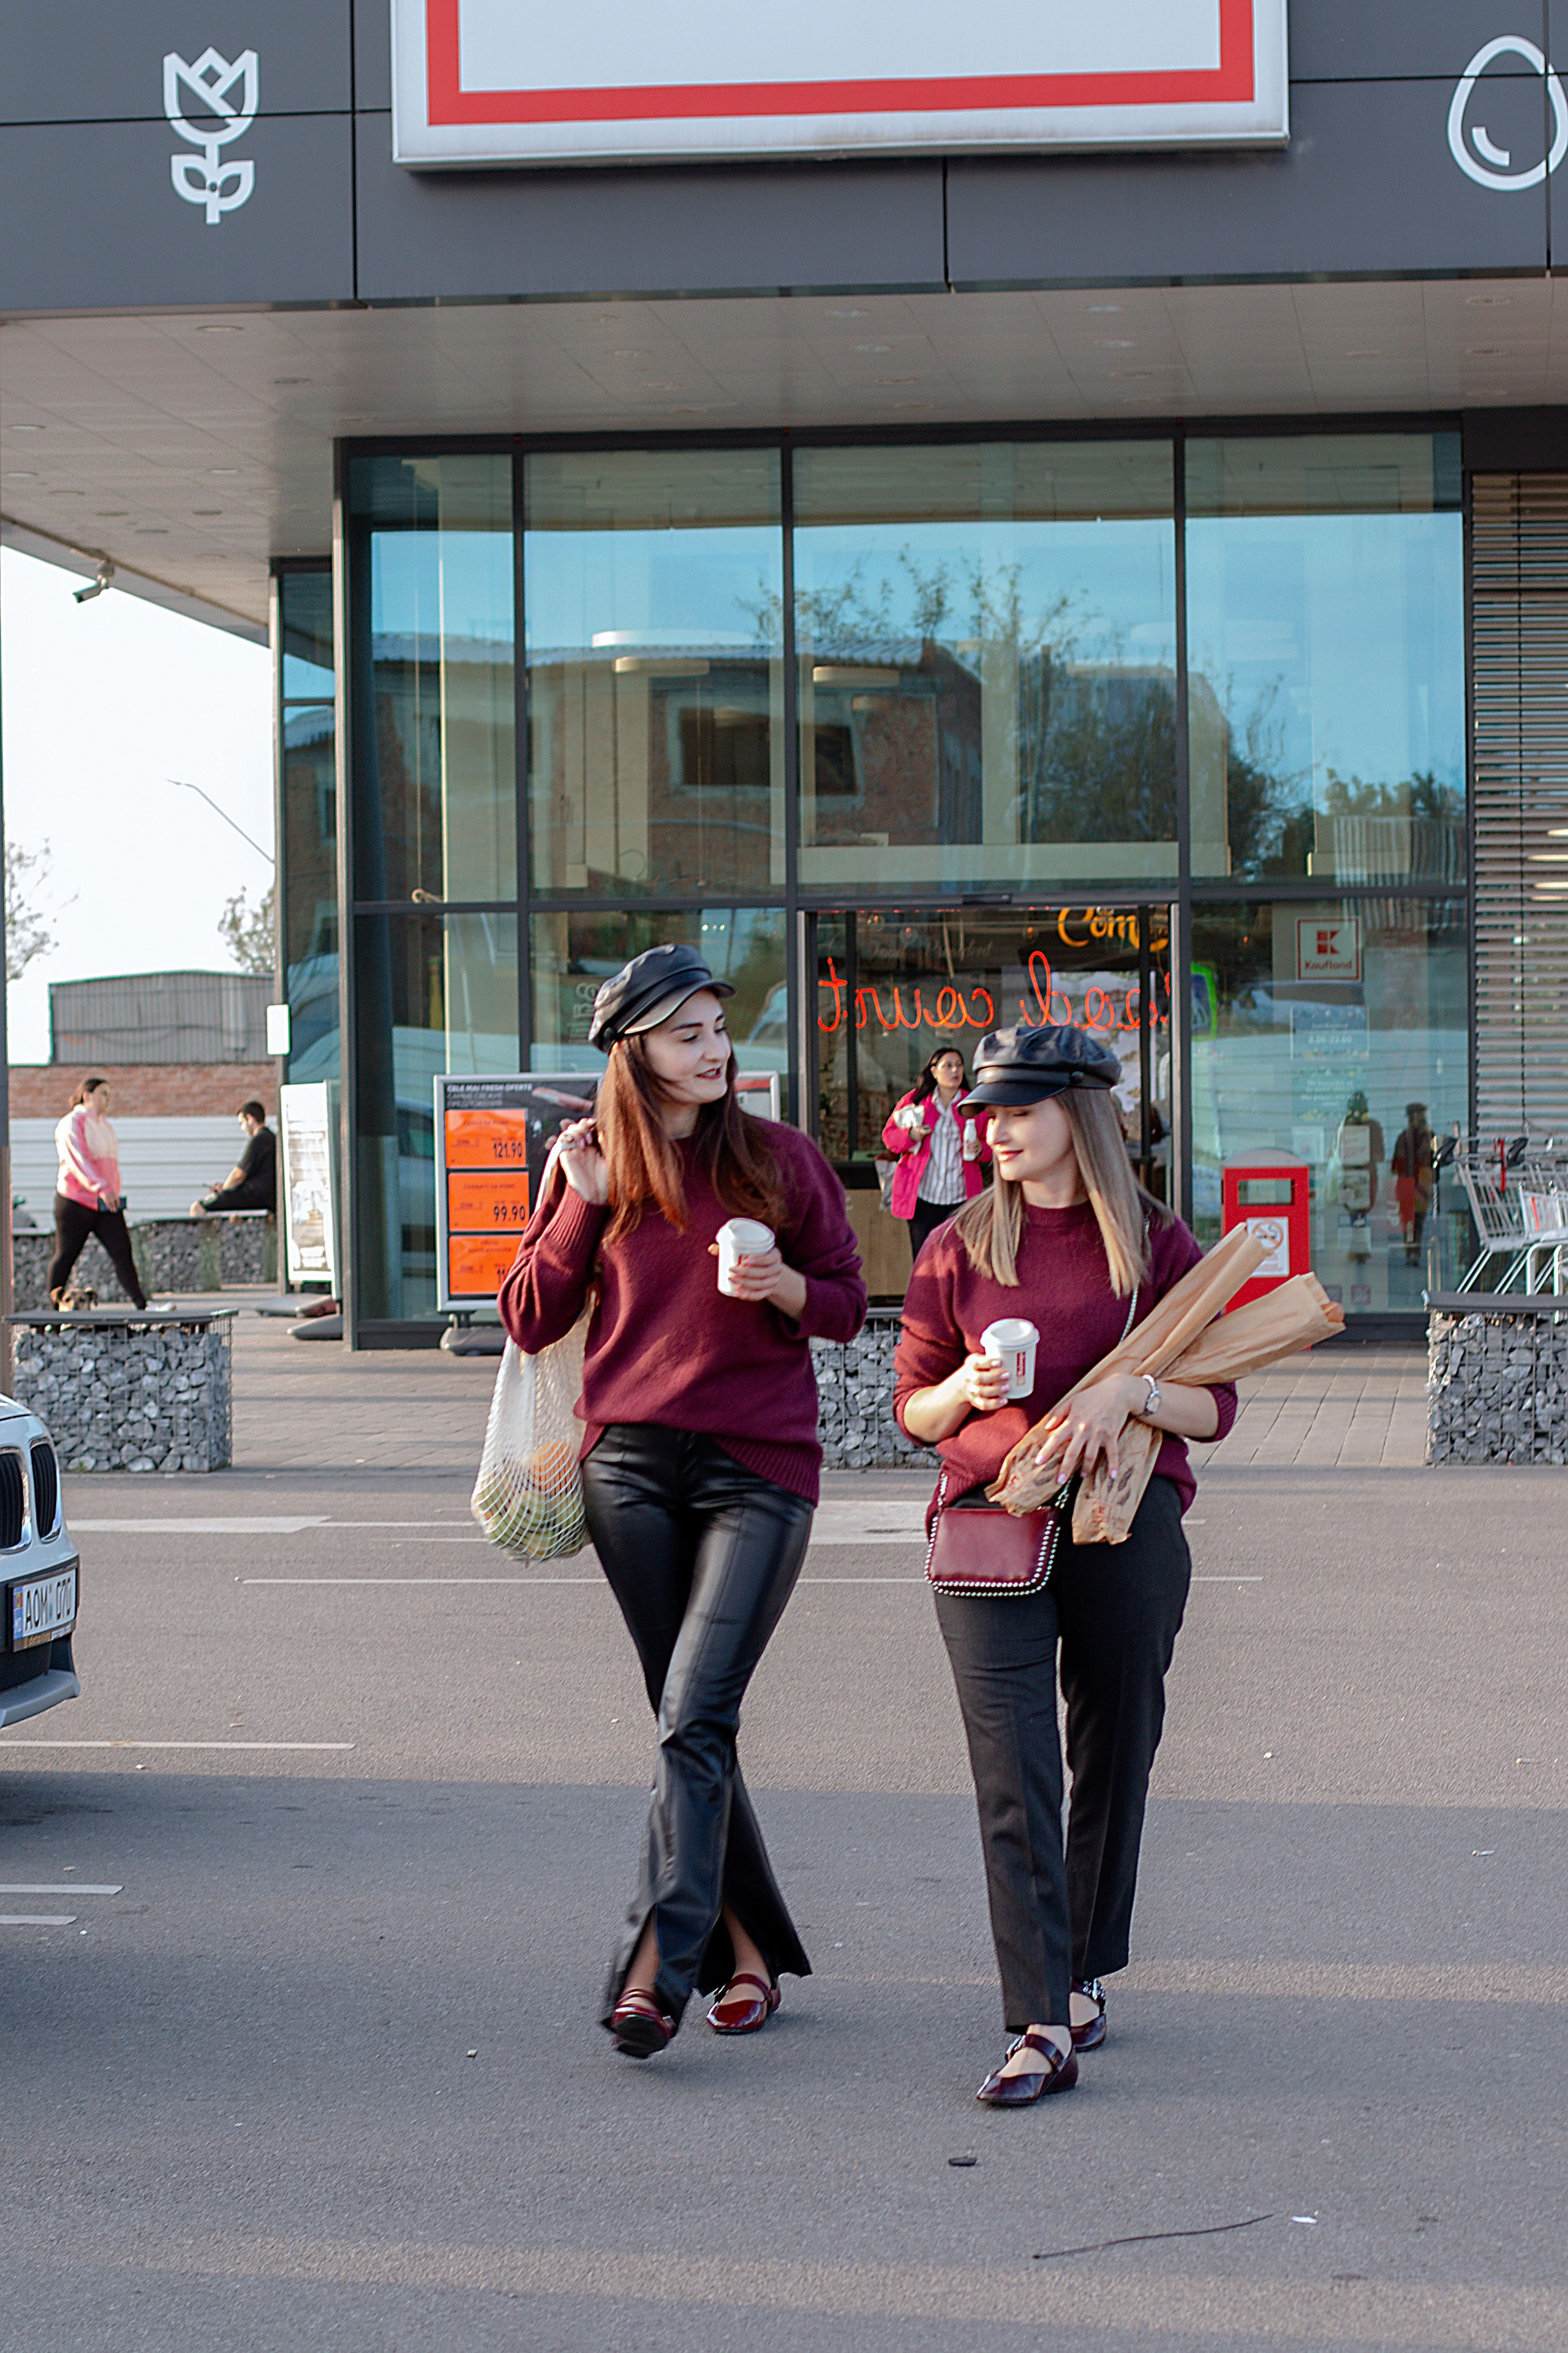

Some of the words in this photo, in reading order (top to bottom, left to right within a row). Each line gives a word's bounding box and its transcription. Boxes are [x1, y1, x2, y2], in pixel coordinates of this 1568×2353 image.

[1317, 930, 1340, 954] K
[1304, 959, 1352, 970] Kaufland
[493, 1142, 523, 1158] 121.90
[493, 1205, 526, 1222] 99.90
